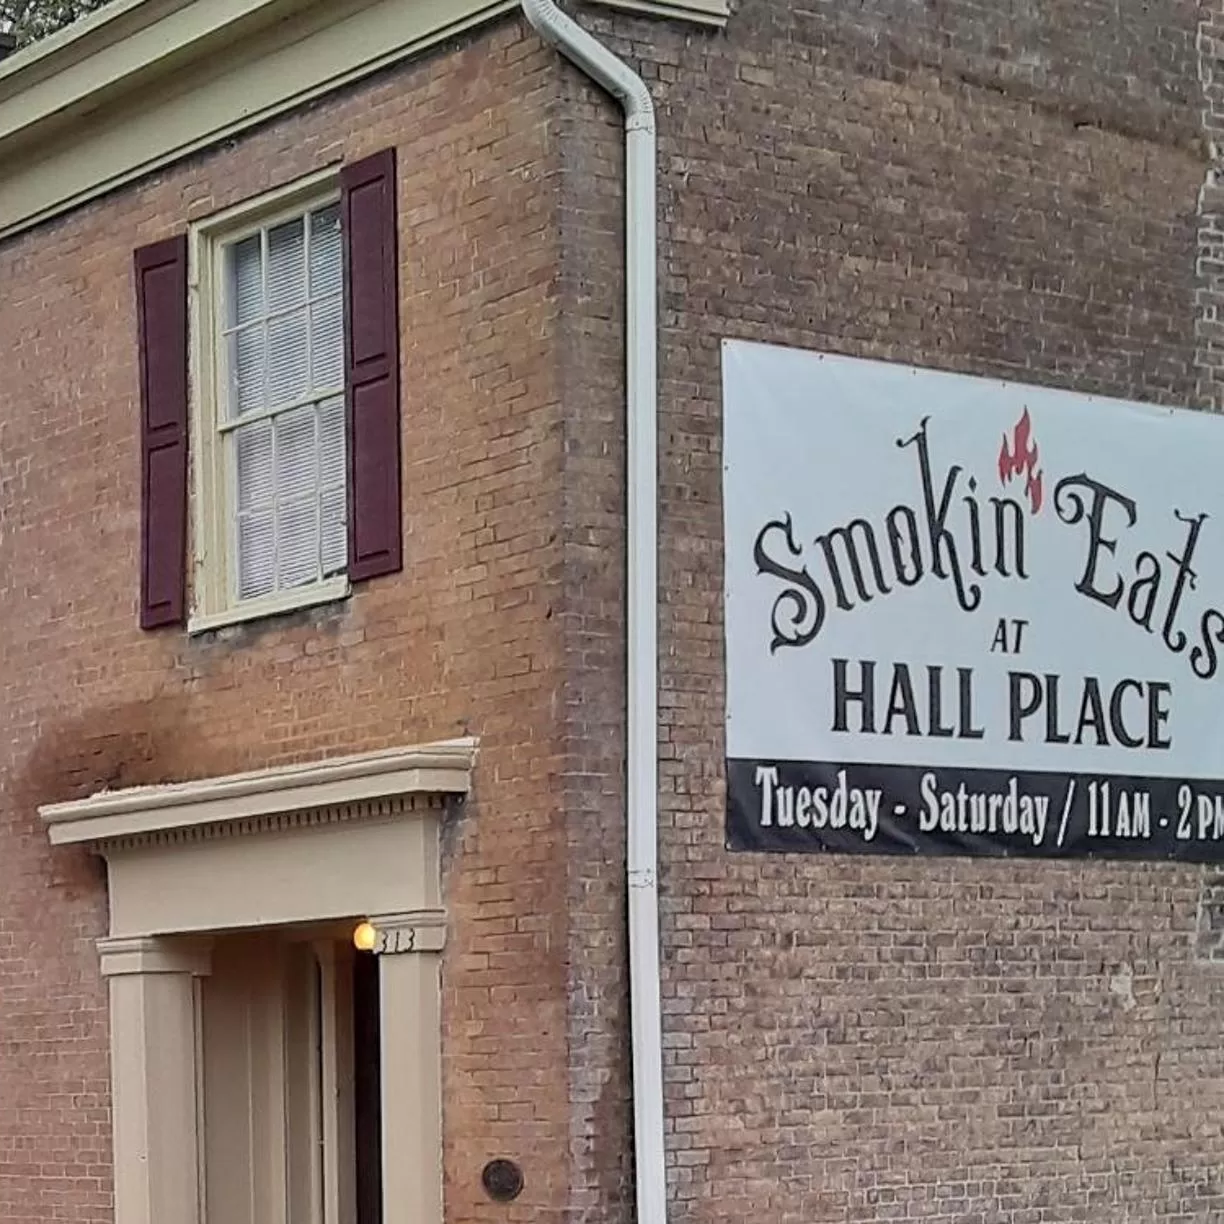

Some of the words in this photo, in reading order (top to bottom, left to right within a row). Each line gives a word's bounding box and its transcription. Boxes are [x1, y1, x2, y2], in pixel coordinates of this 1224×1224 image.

[1054, 472, 1224, 679] Eats
[990, 618, 1029, 654] AT
[831, 658, 985, 740] HALL
[1007, 671, 1173, 750] PLACE
[755, 766, 882, 841] Tuesday
[919, 772, 1049, 848] Saturday
[1056, 779, 1076, 848] /
